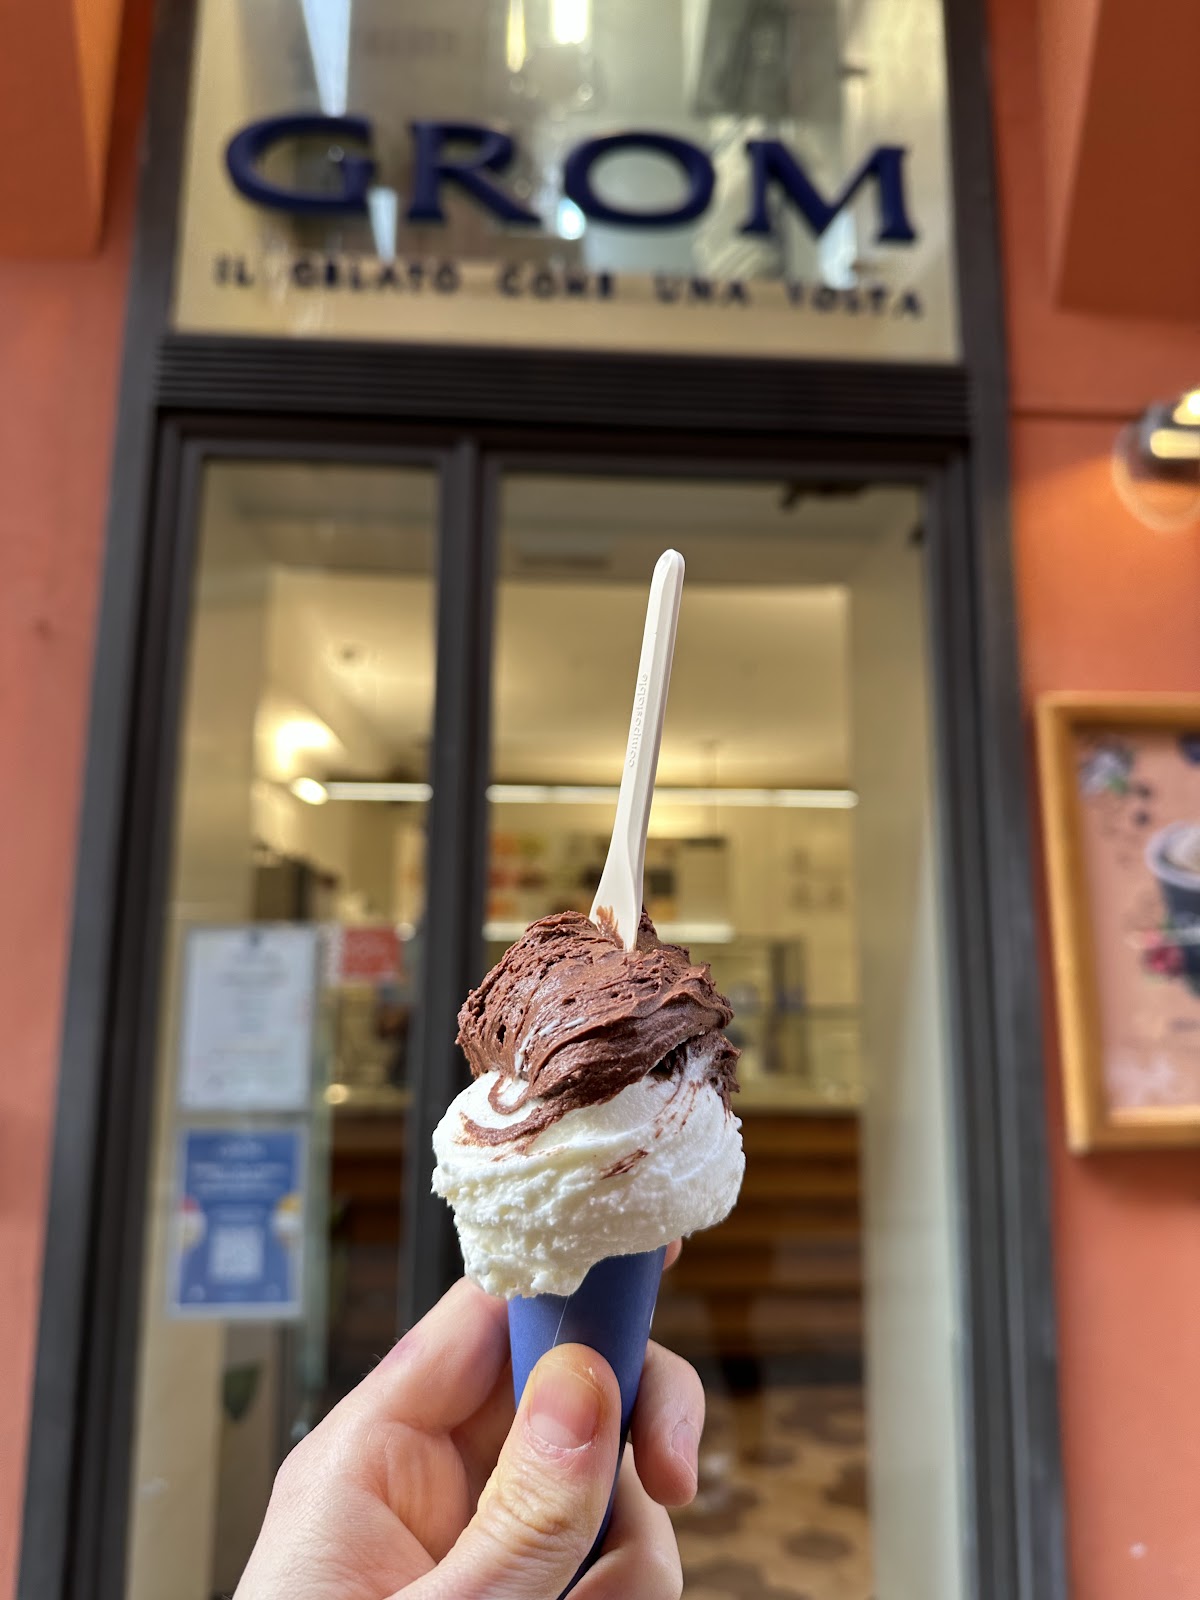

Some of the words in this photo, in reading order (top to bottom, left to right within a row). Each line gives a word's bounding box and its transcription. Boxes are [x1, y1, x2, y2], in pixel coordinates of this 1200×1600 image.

[225, 114, 917, 245] GROM
[214, 255, 254, 288] IL
[293, 259, 462, 294] GELATO
[628, 673, 648, 768] compostable
